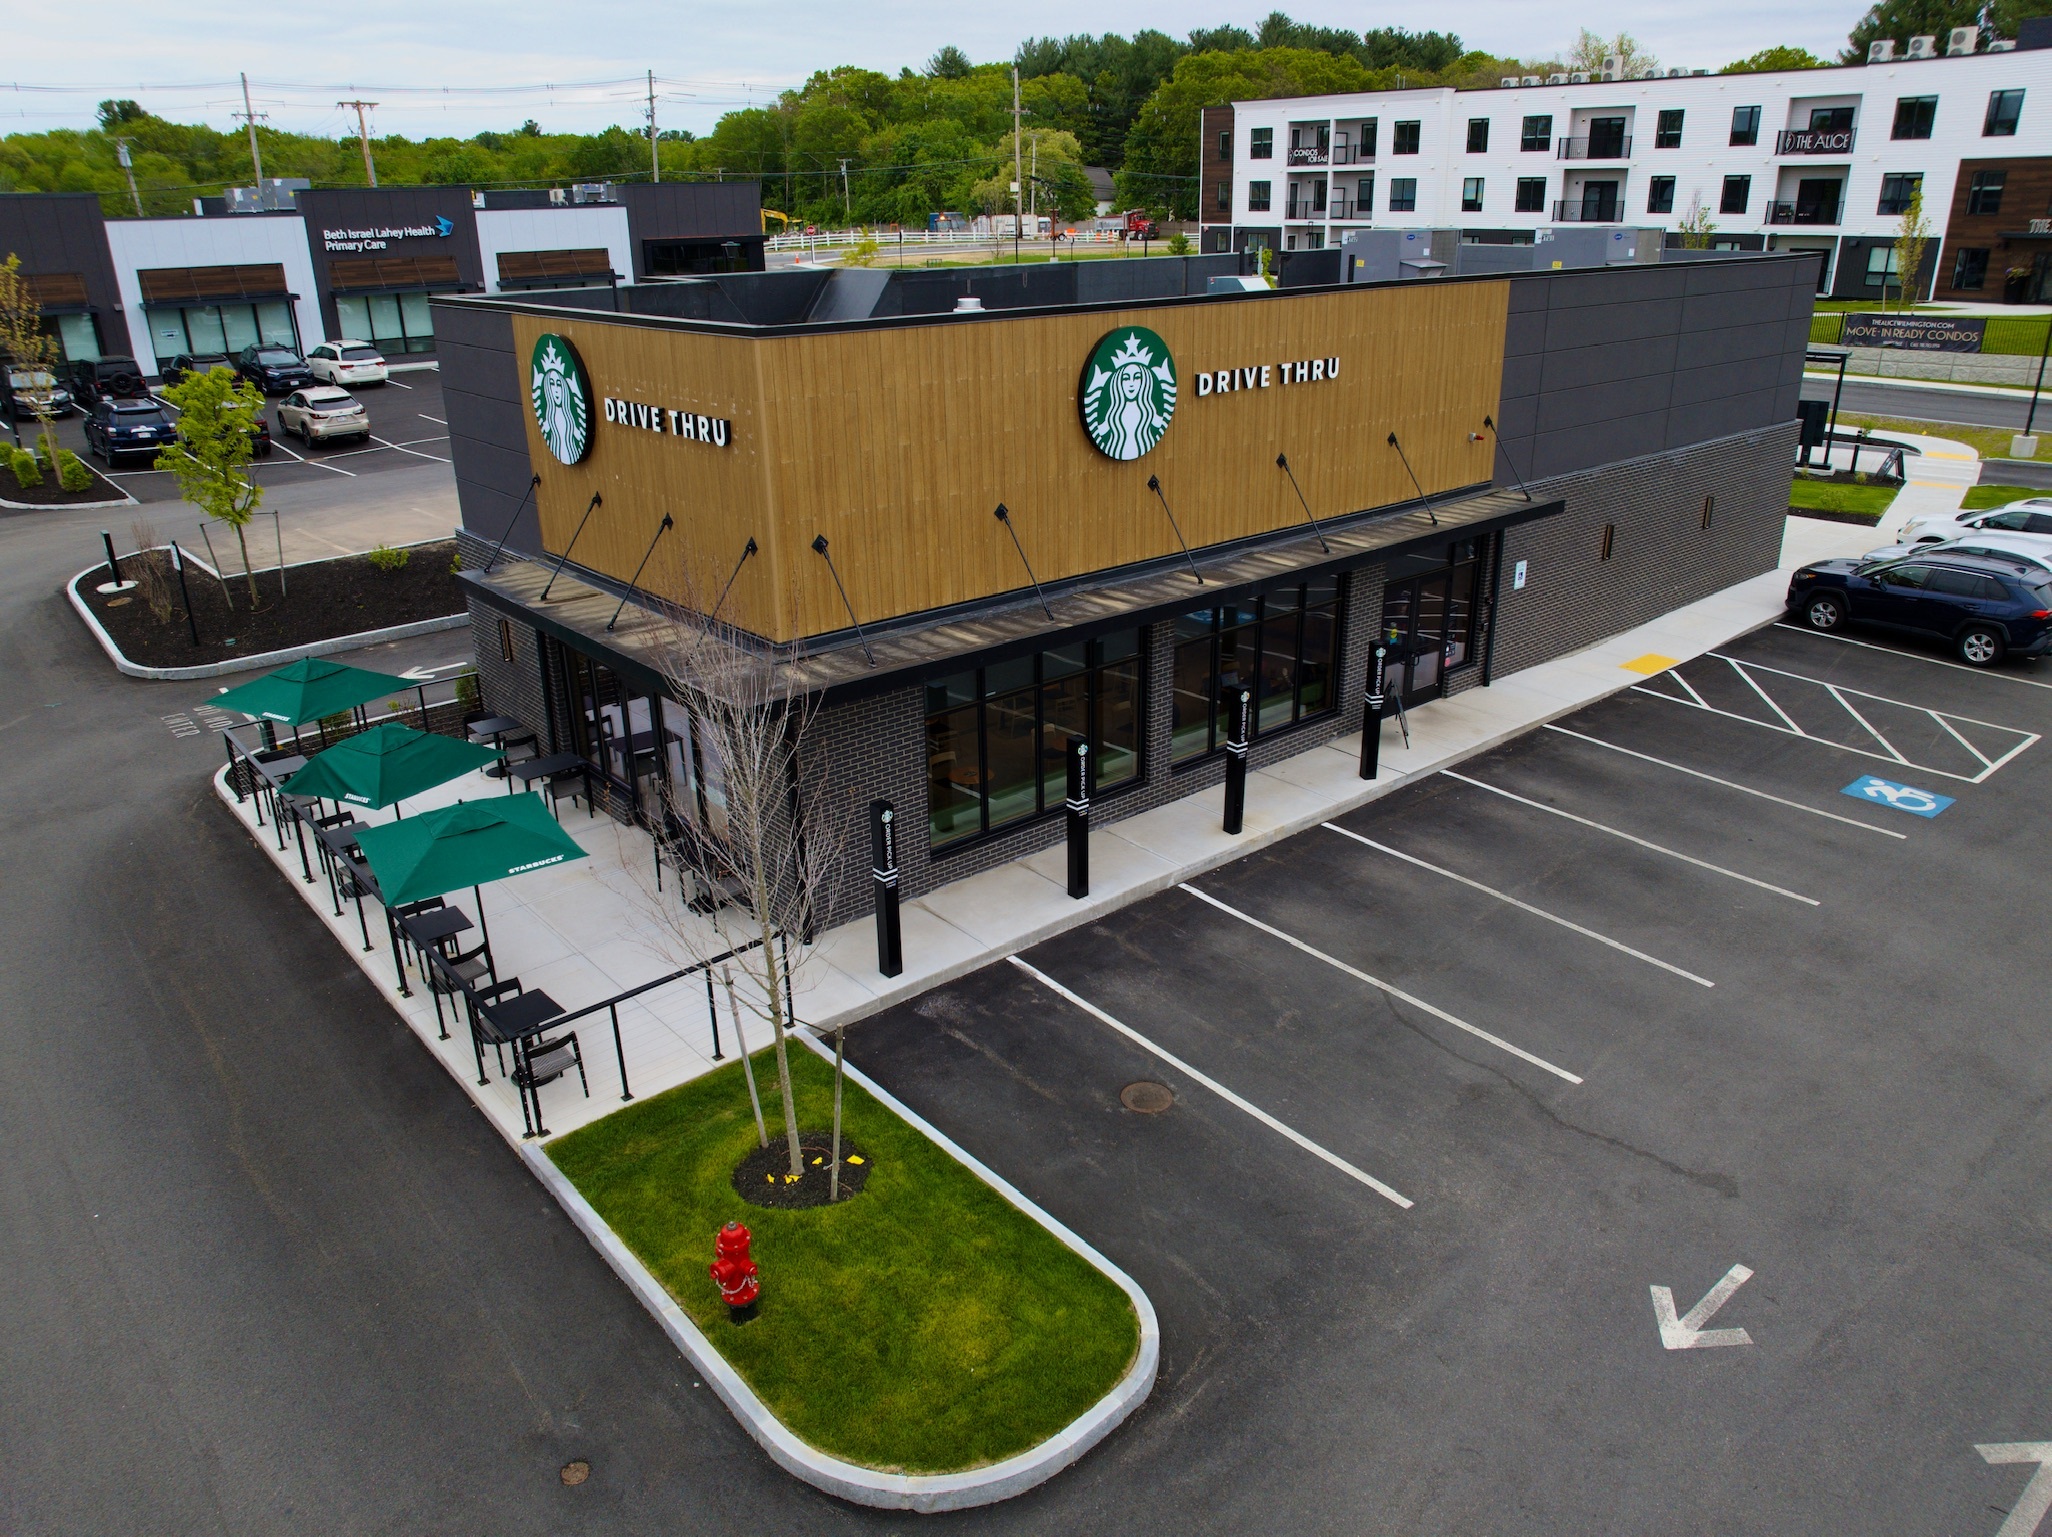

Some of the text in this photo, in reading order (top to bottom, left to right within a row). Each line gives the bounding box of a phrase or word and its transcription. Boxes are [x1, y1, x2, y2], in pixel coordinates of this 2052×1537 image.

[1796, 133, 1851, 149] THE ALICE
[1294, 149, 1318, 157] CONDOS
[323, 225, 436, 240] Beth Israel Lahey Health
[325, 240, 387, 253] Primary Care
[1892, 328, 1926, 339] READY
[1927, 330, 1979, 342] CONDOS
[1197, 357, 1340, 397] DRIVE THRU
[604, 397, 728, 447] DRIVE THRU
[161, 712, 200, 739] ENTER
